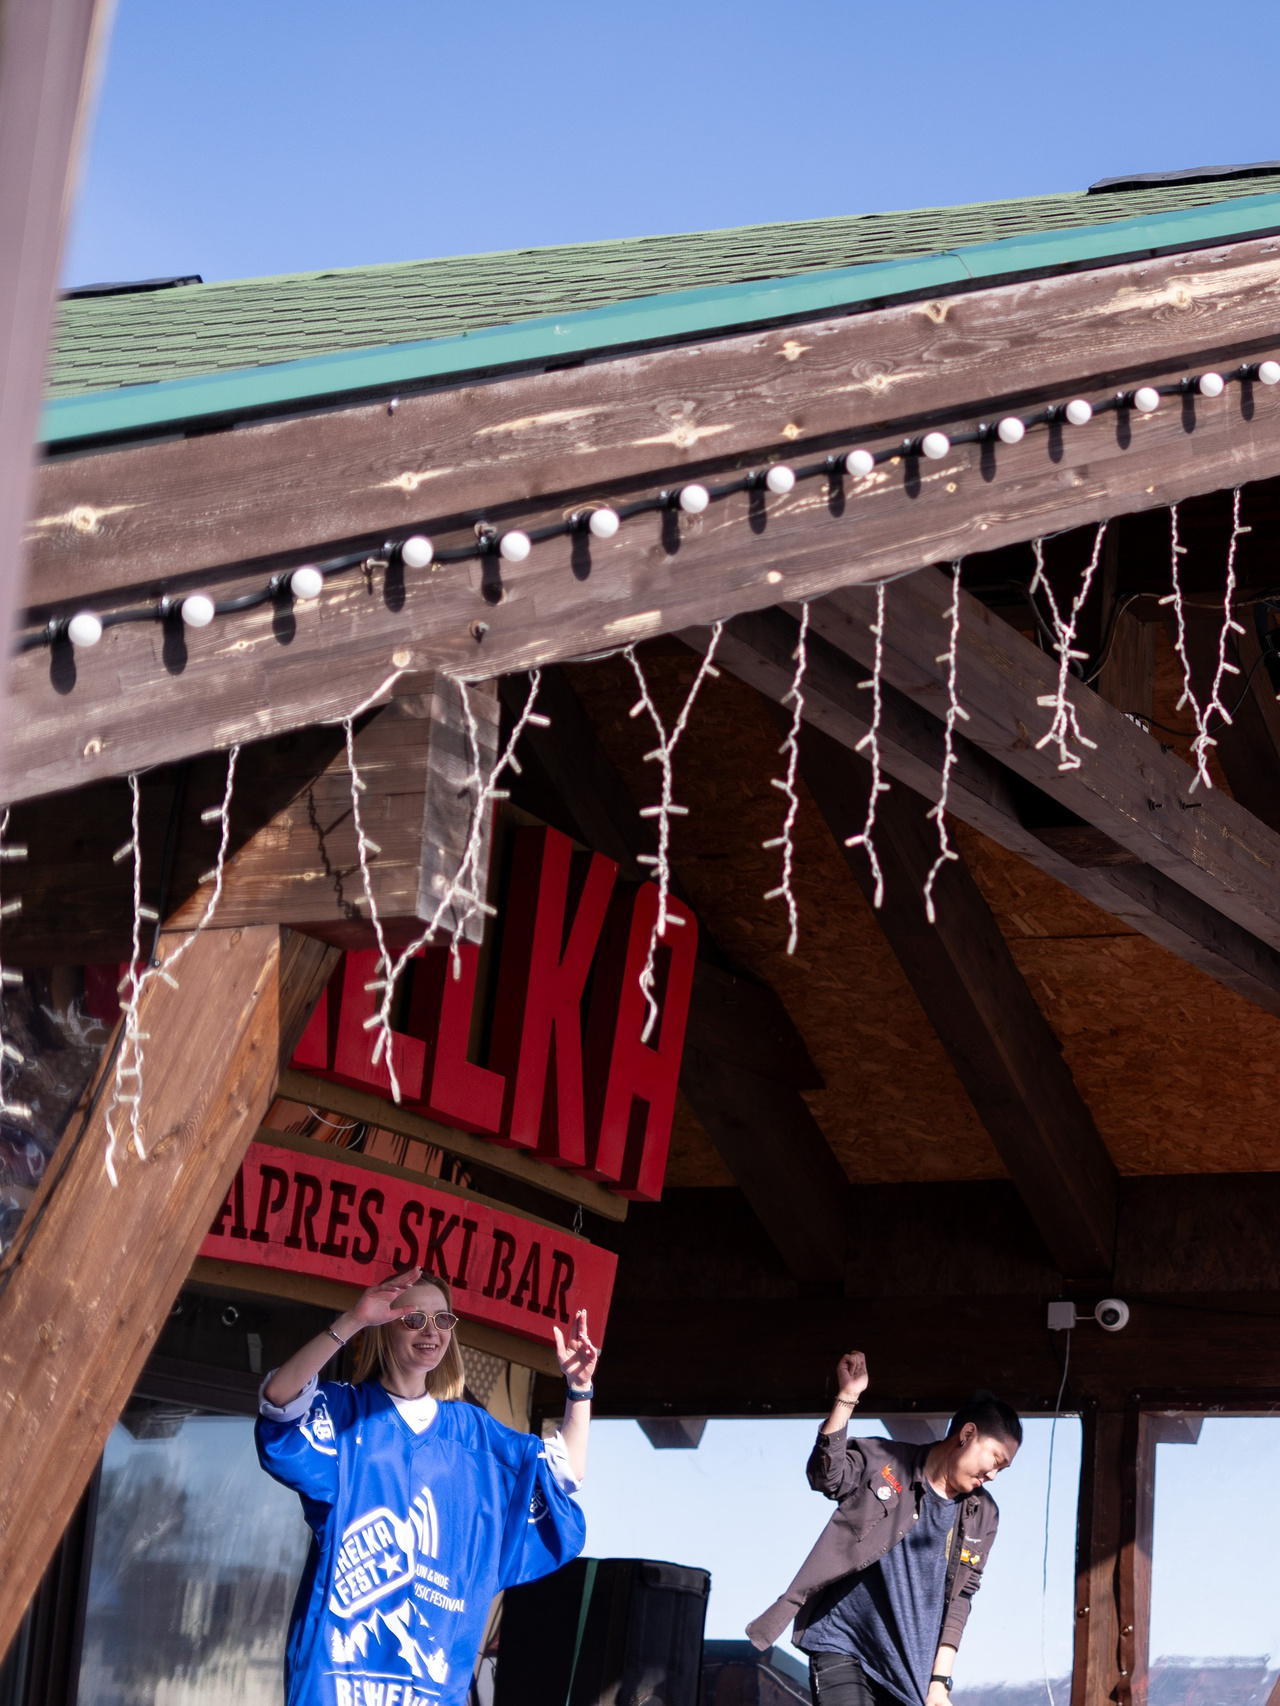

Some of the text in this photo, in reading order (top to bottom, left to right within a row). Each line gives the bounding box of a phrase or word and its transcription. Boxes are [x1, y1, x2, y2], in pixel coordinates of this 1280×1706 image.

[212, 1160, 575, 1324] APRES SKI BAR
[334, 1520, 394, 1581] RELKA
[335, 1558, 380, 1606] FEST
[427, 1569, 434, 1583] &
[433, 1571, 450, 1591] RIDE
[429, 1590, 465, 1613] FESTIVAL
